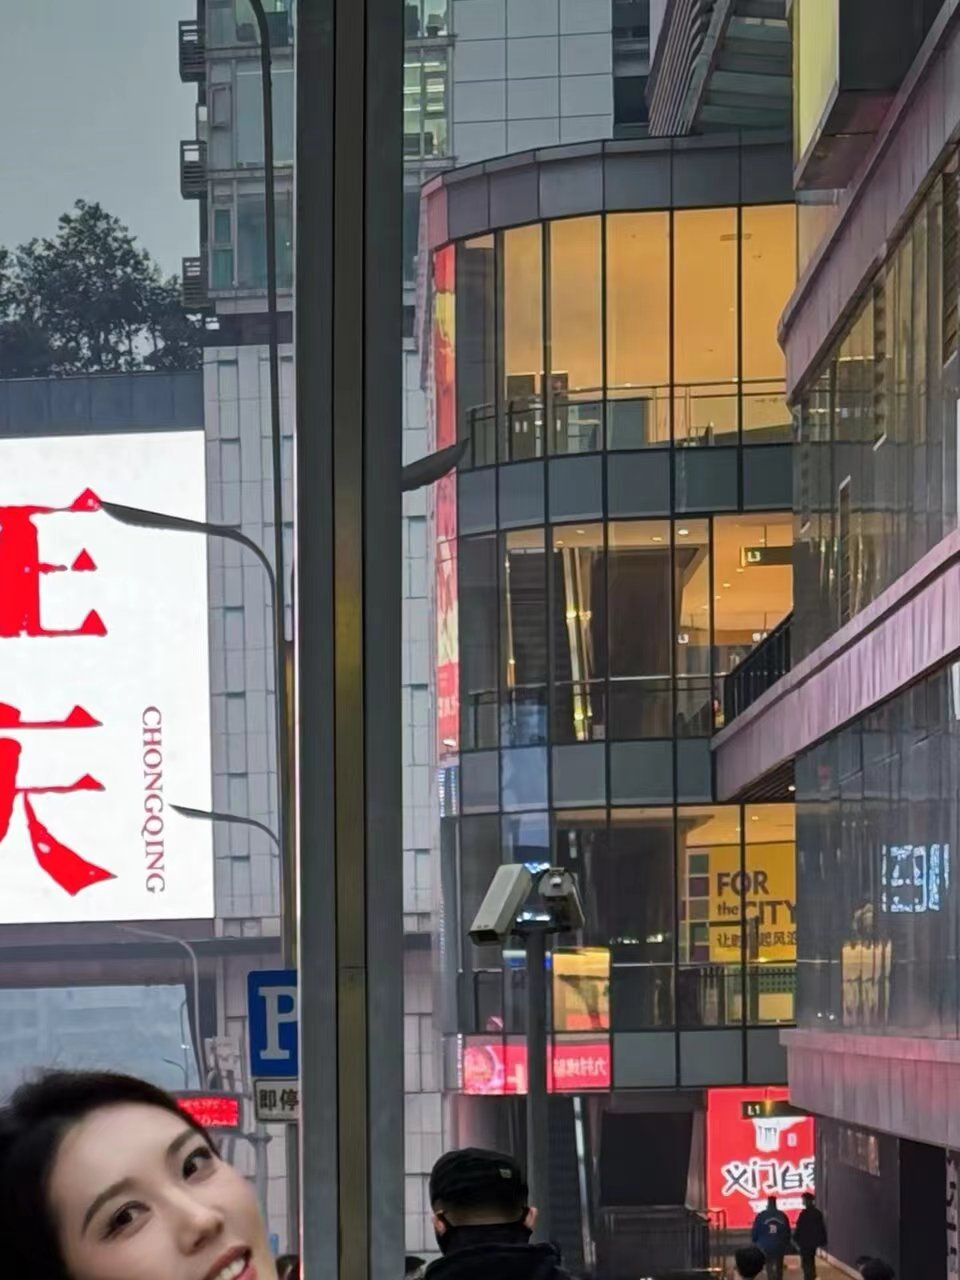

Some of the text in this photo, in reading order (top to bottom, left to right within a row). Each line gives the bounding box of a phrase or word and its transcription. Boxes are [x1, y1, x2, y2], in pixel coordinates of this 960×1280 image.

[141, 706, 166, 893] CHONGQING
[717, 870, 769, 897] FOR
[717, 902, 739, 917] the
[258, 986, 298, 1060] P
